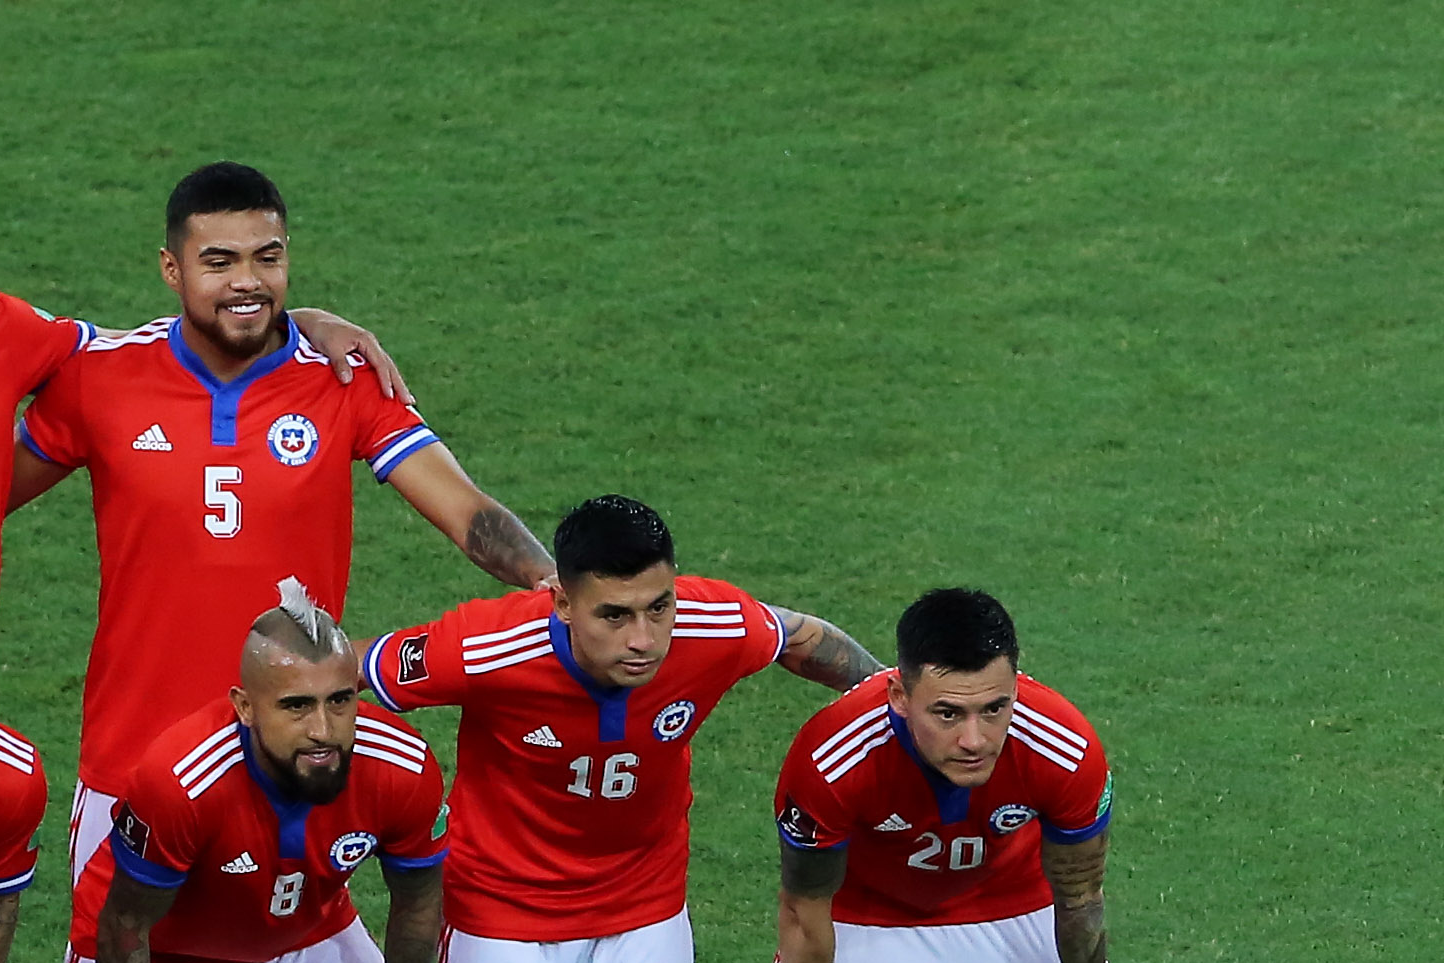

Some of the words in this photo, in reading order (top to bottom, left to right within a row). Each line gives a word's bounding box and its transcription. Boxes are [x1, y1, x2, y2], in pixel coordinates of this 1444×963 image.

[132, 440, 173, 451] adidas
[204, 466, 243, 539] 5
[523, 736, 562, 748] adidas
[567, 752, 640, 800] 16
[220, 864, 259, 874] adidas
[908, 831, 987, 871] 20
[269, 871, 305, 918] 8
